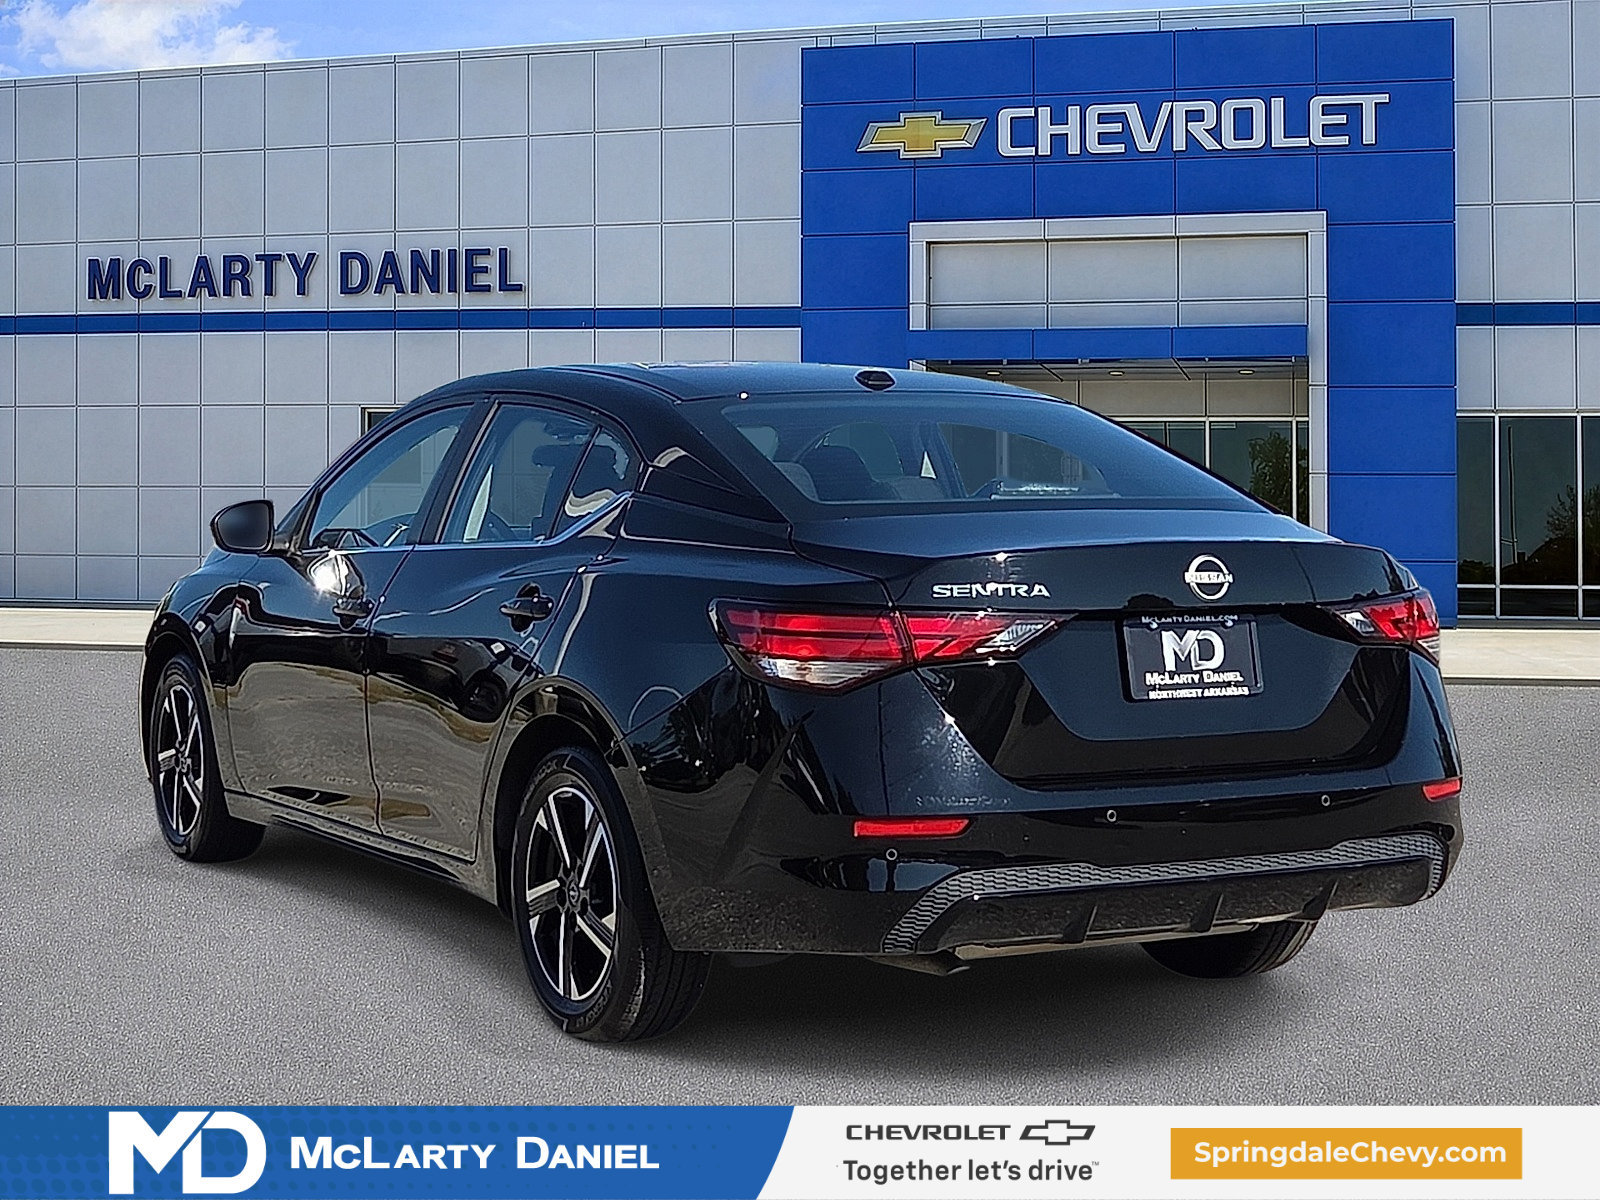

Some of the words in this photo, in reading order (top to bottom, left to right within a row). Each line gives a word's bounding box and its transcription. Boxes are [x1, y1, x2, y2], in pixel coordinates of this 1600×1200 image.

[997, 93, 1390, 158] CHEVROLET
[338, 245, 525, 296] DANIEL
[932, 582, 1051, 599] SENTRA
[1161, 629, 1225, 672] MD
